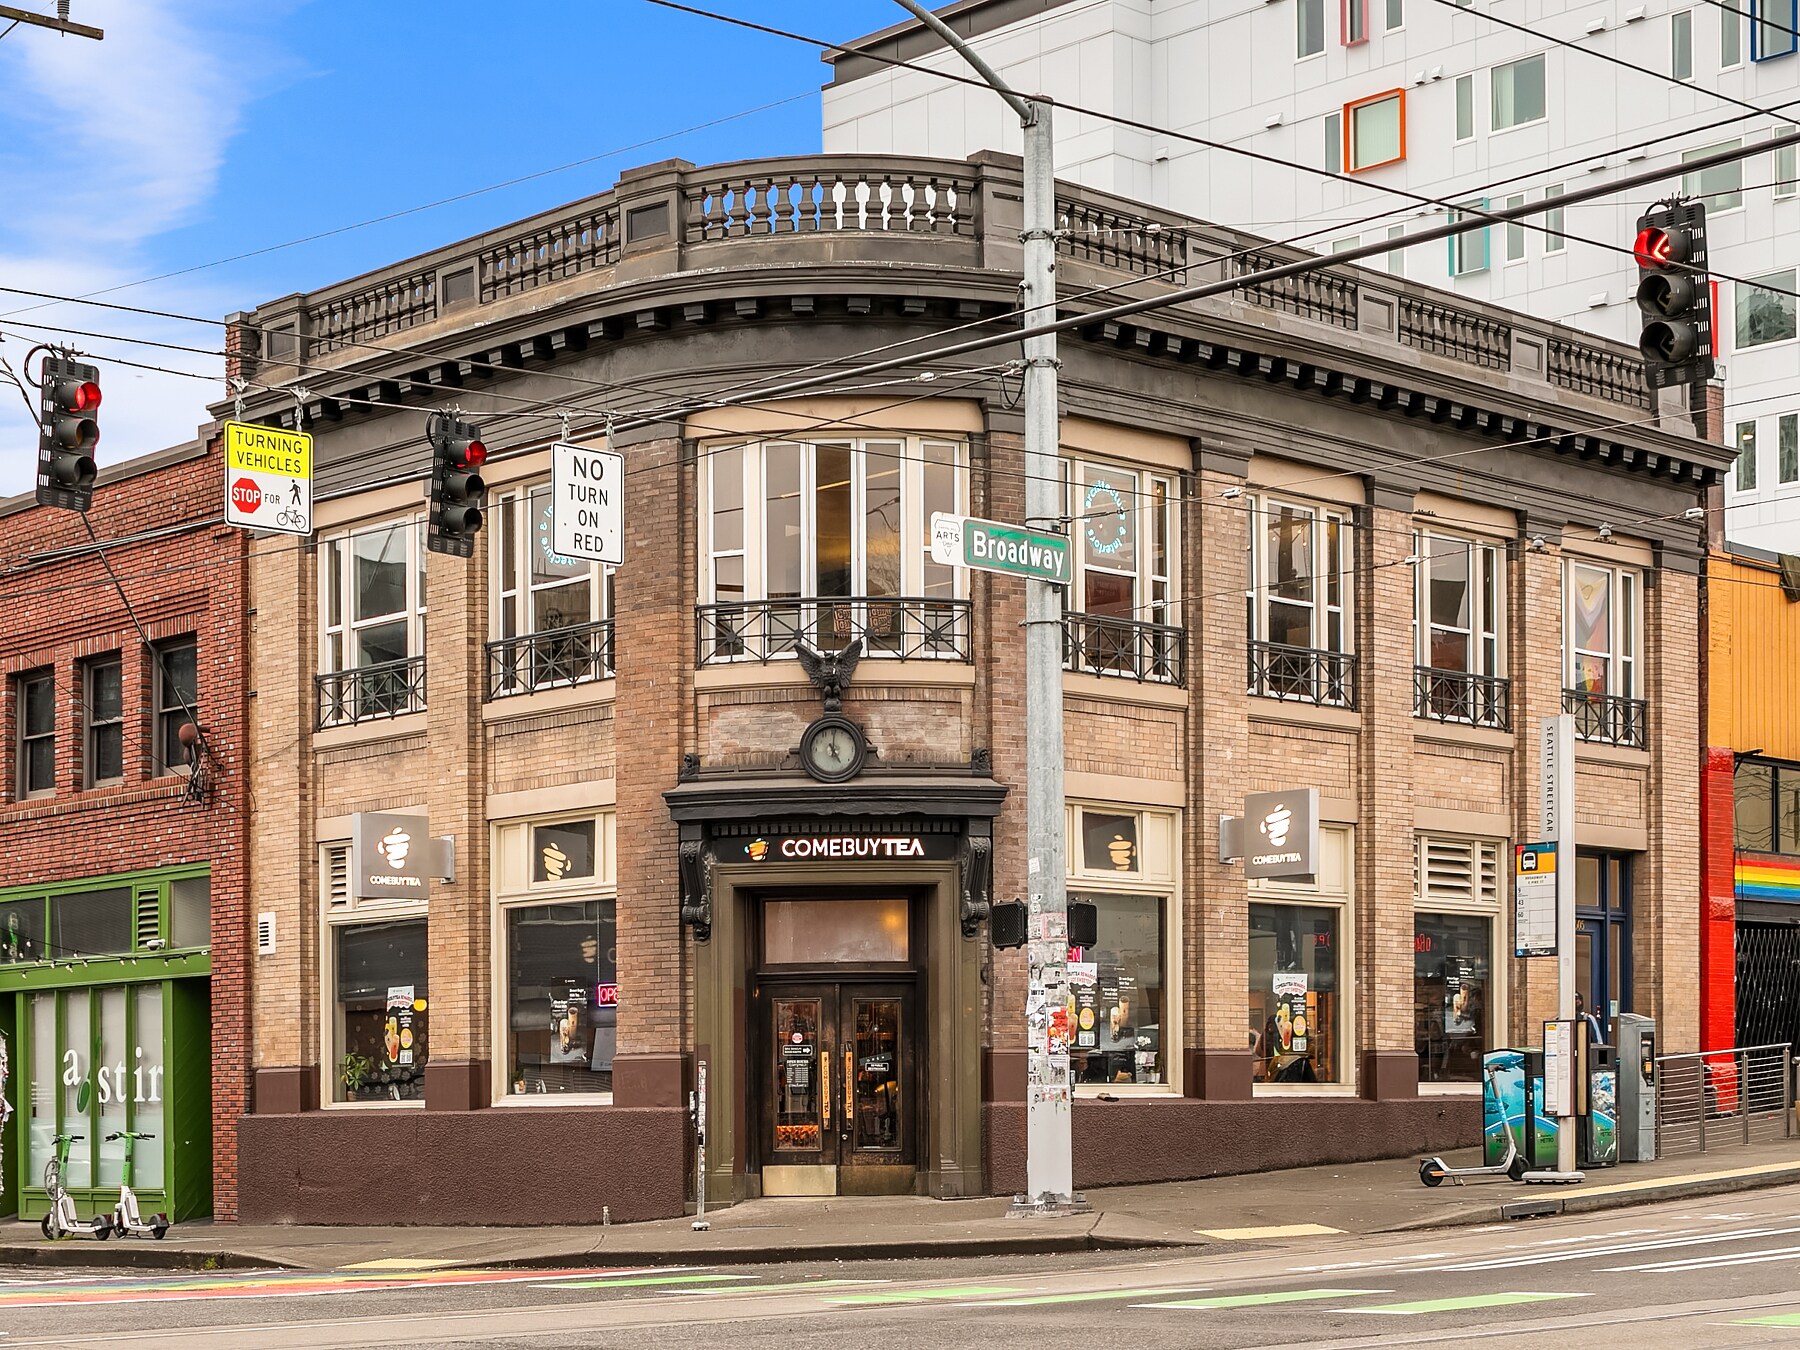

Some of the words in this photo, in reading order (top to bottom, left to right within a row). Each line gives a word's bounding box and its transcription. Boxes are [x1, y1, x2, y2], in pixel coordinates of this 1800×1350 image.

[235, 430, 303, 454] TURNING
[236, 450, 302, 474] VEHICLES
[573, 455, 604, 481] NO
[232, 487, 261, 504] STOP
[264, 493, 281, 505] FOR
[567, 483, 608, 507] TURN
[578, 509, 599, 529] ON
[573, 532, 604, 553] RED
[935, 530, 960, 543] ARTS
[973, 530, 1064, 577] Broadway
[1546, 725, 1554, 769] SEATTLE
[1546, 774, 1554, 832] STREETCAR
[781, 838, 925, 857] COMEBUYTEA
[1252, 852, 1302, 865] COMEBUYTEA
[369, 875, 422, 887] COMEBUYTEA
[600, 987, 618, 1002] OPE
